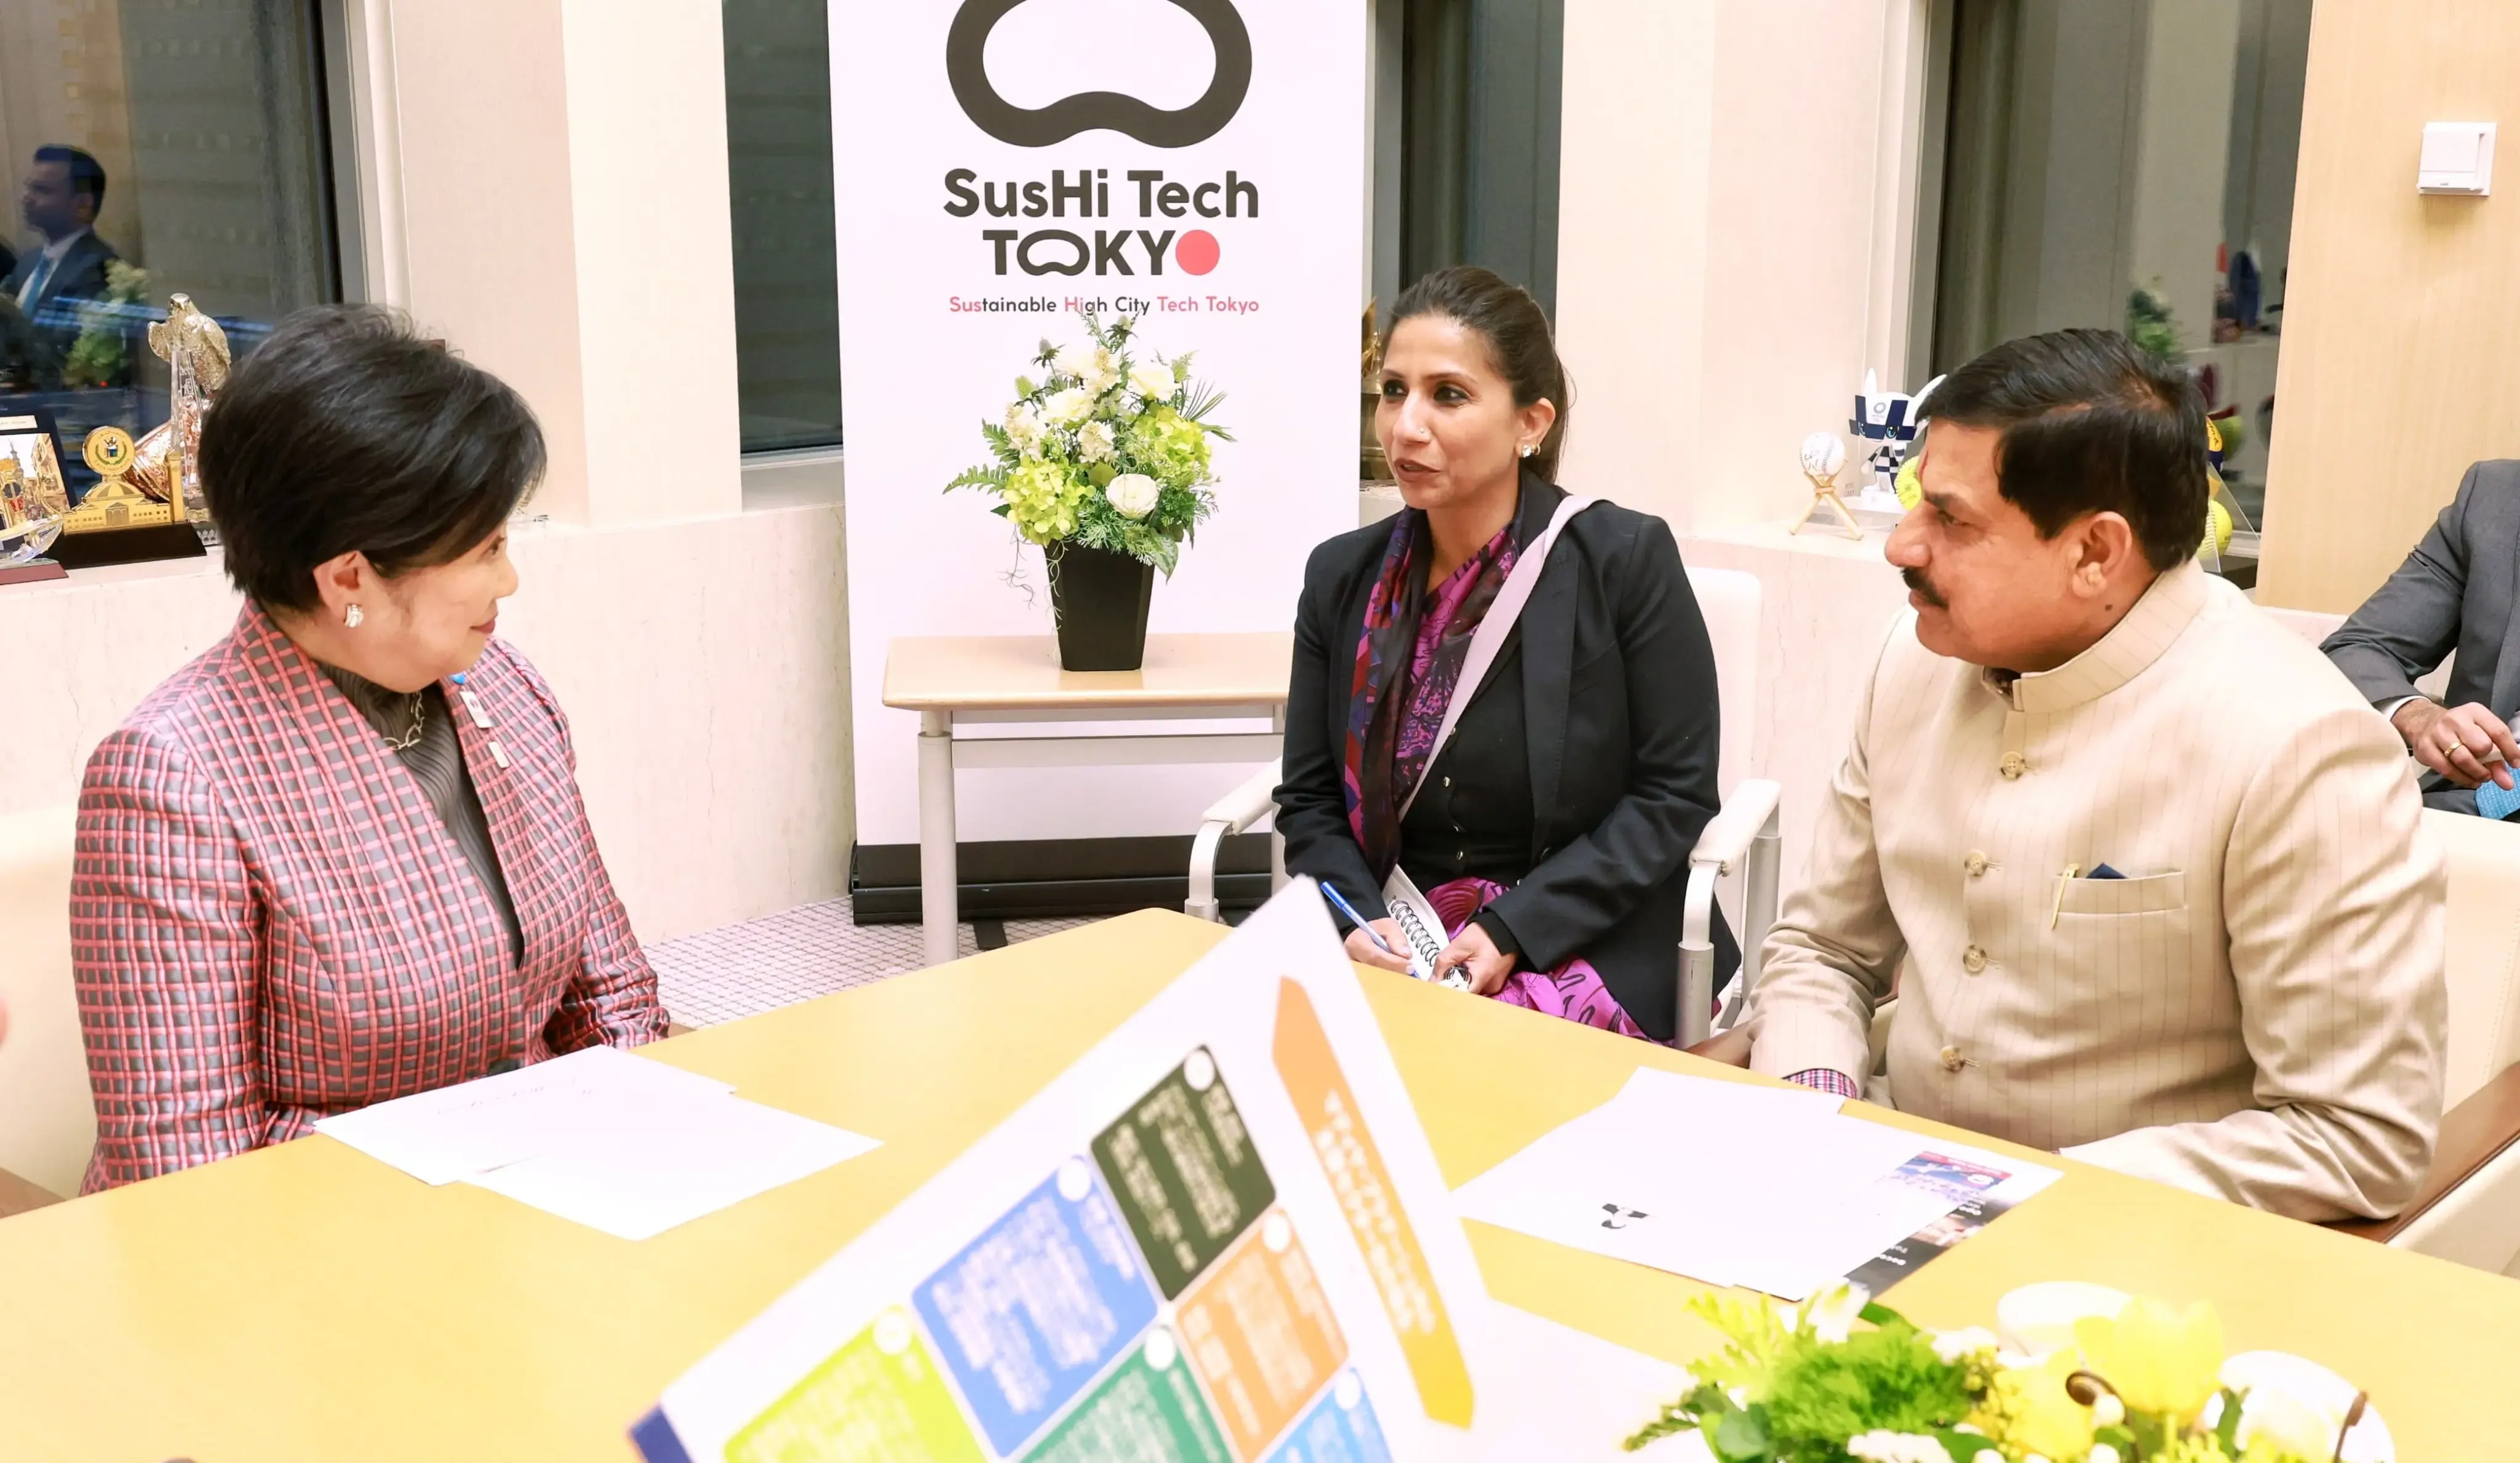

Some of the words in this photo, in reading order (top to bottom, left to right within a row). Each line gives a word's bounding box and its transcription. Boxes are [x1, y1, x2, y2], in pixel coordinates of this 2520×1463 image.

[943, 167, 1109, 218] SusHi
[1126, 170, 1259, 219] Tech
[949, 295, 1057, 313] Sustainable
[1064, 295, 1108, 316] High
[1114, 295, 1151, 316] City
[1156, 295, 1198, 313] Tech
[1205, 295, 1259, 316] Tokyo
